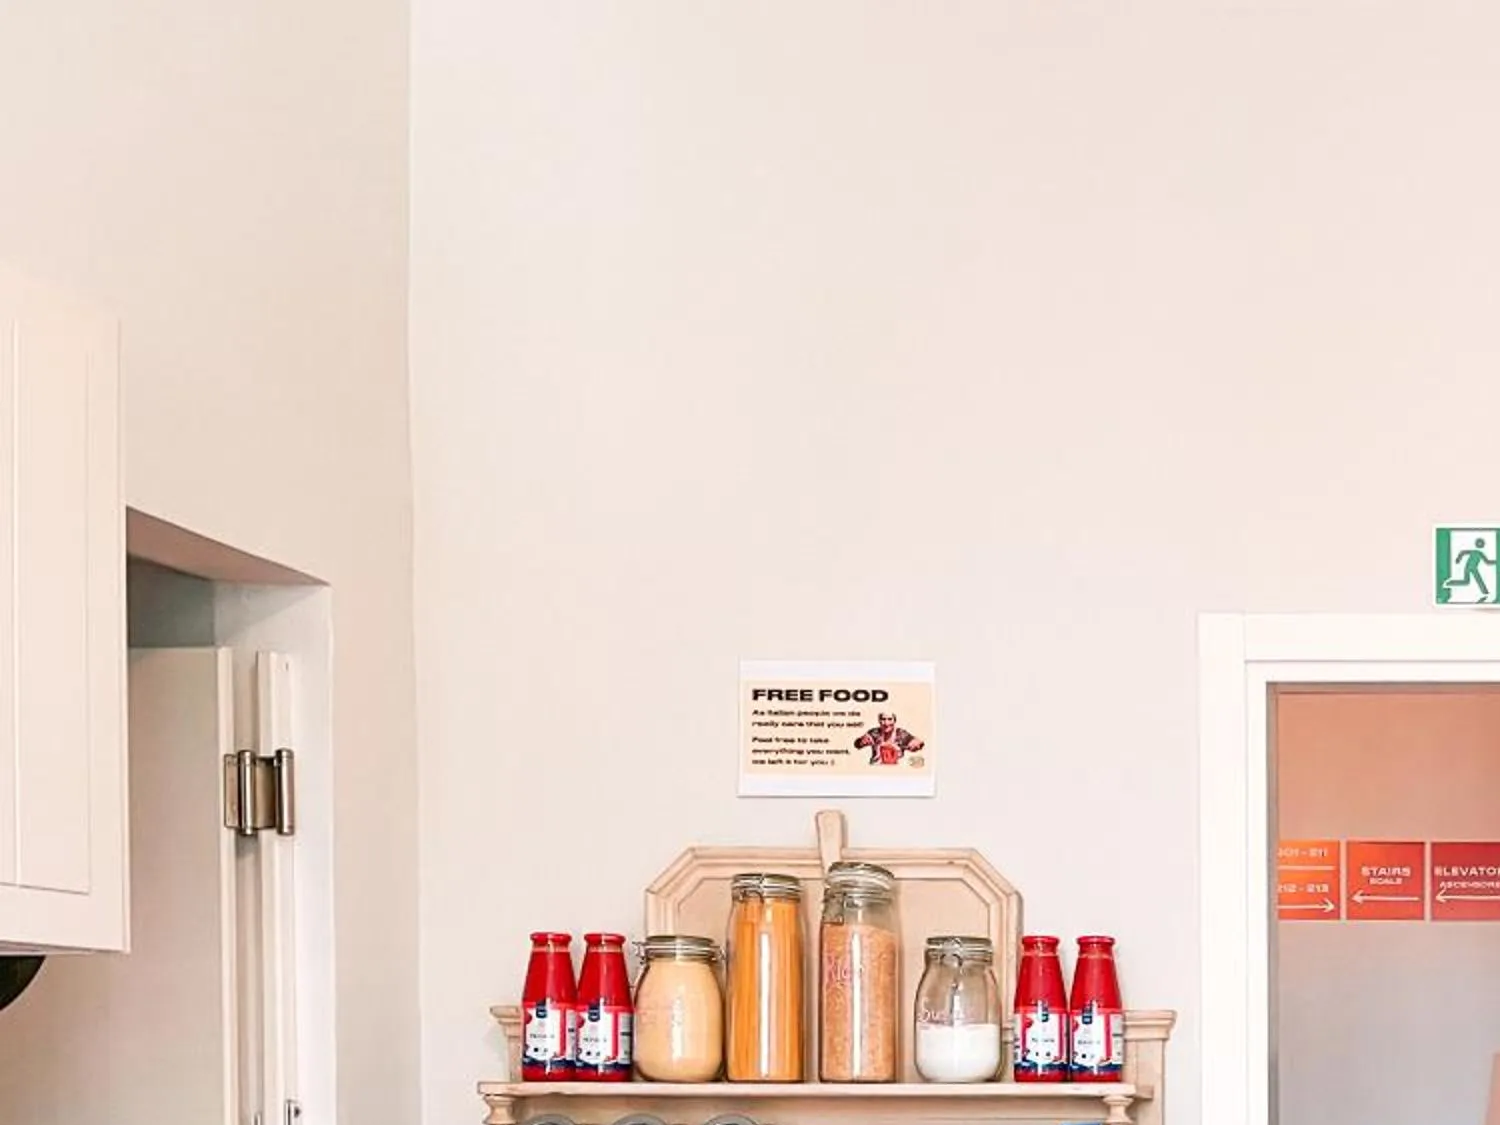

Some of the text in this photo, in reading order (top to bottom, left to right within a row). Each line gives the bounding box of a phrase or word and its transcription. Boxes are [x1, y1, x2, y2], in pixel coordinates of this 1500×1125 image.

[752, 689, 889, 702] FREE FOOD
[752, 748, 804, 756] everything
[1361, 866, 1411, 876] STAIRS
[1369, 877, 1403, 885] SCALE
[1439, 880, 1500, 889] ASCENSORE
